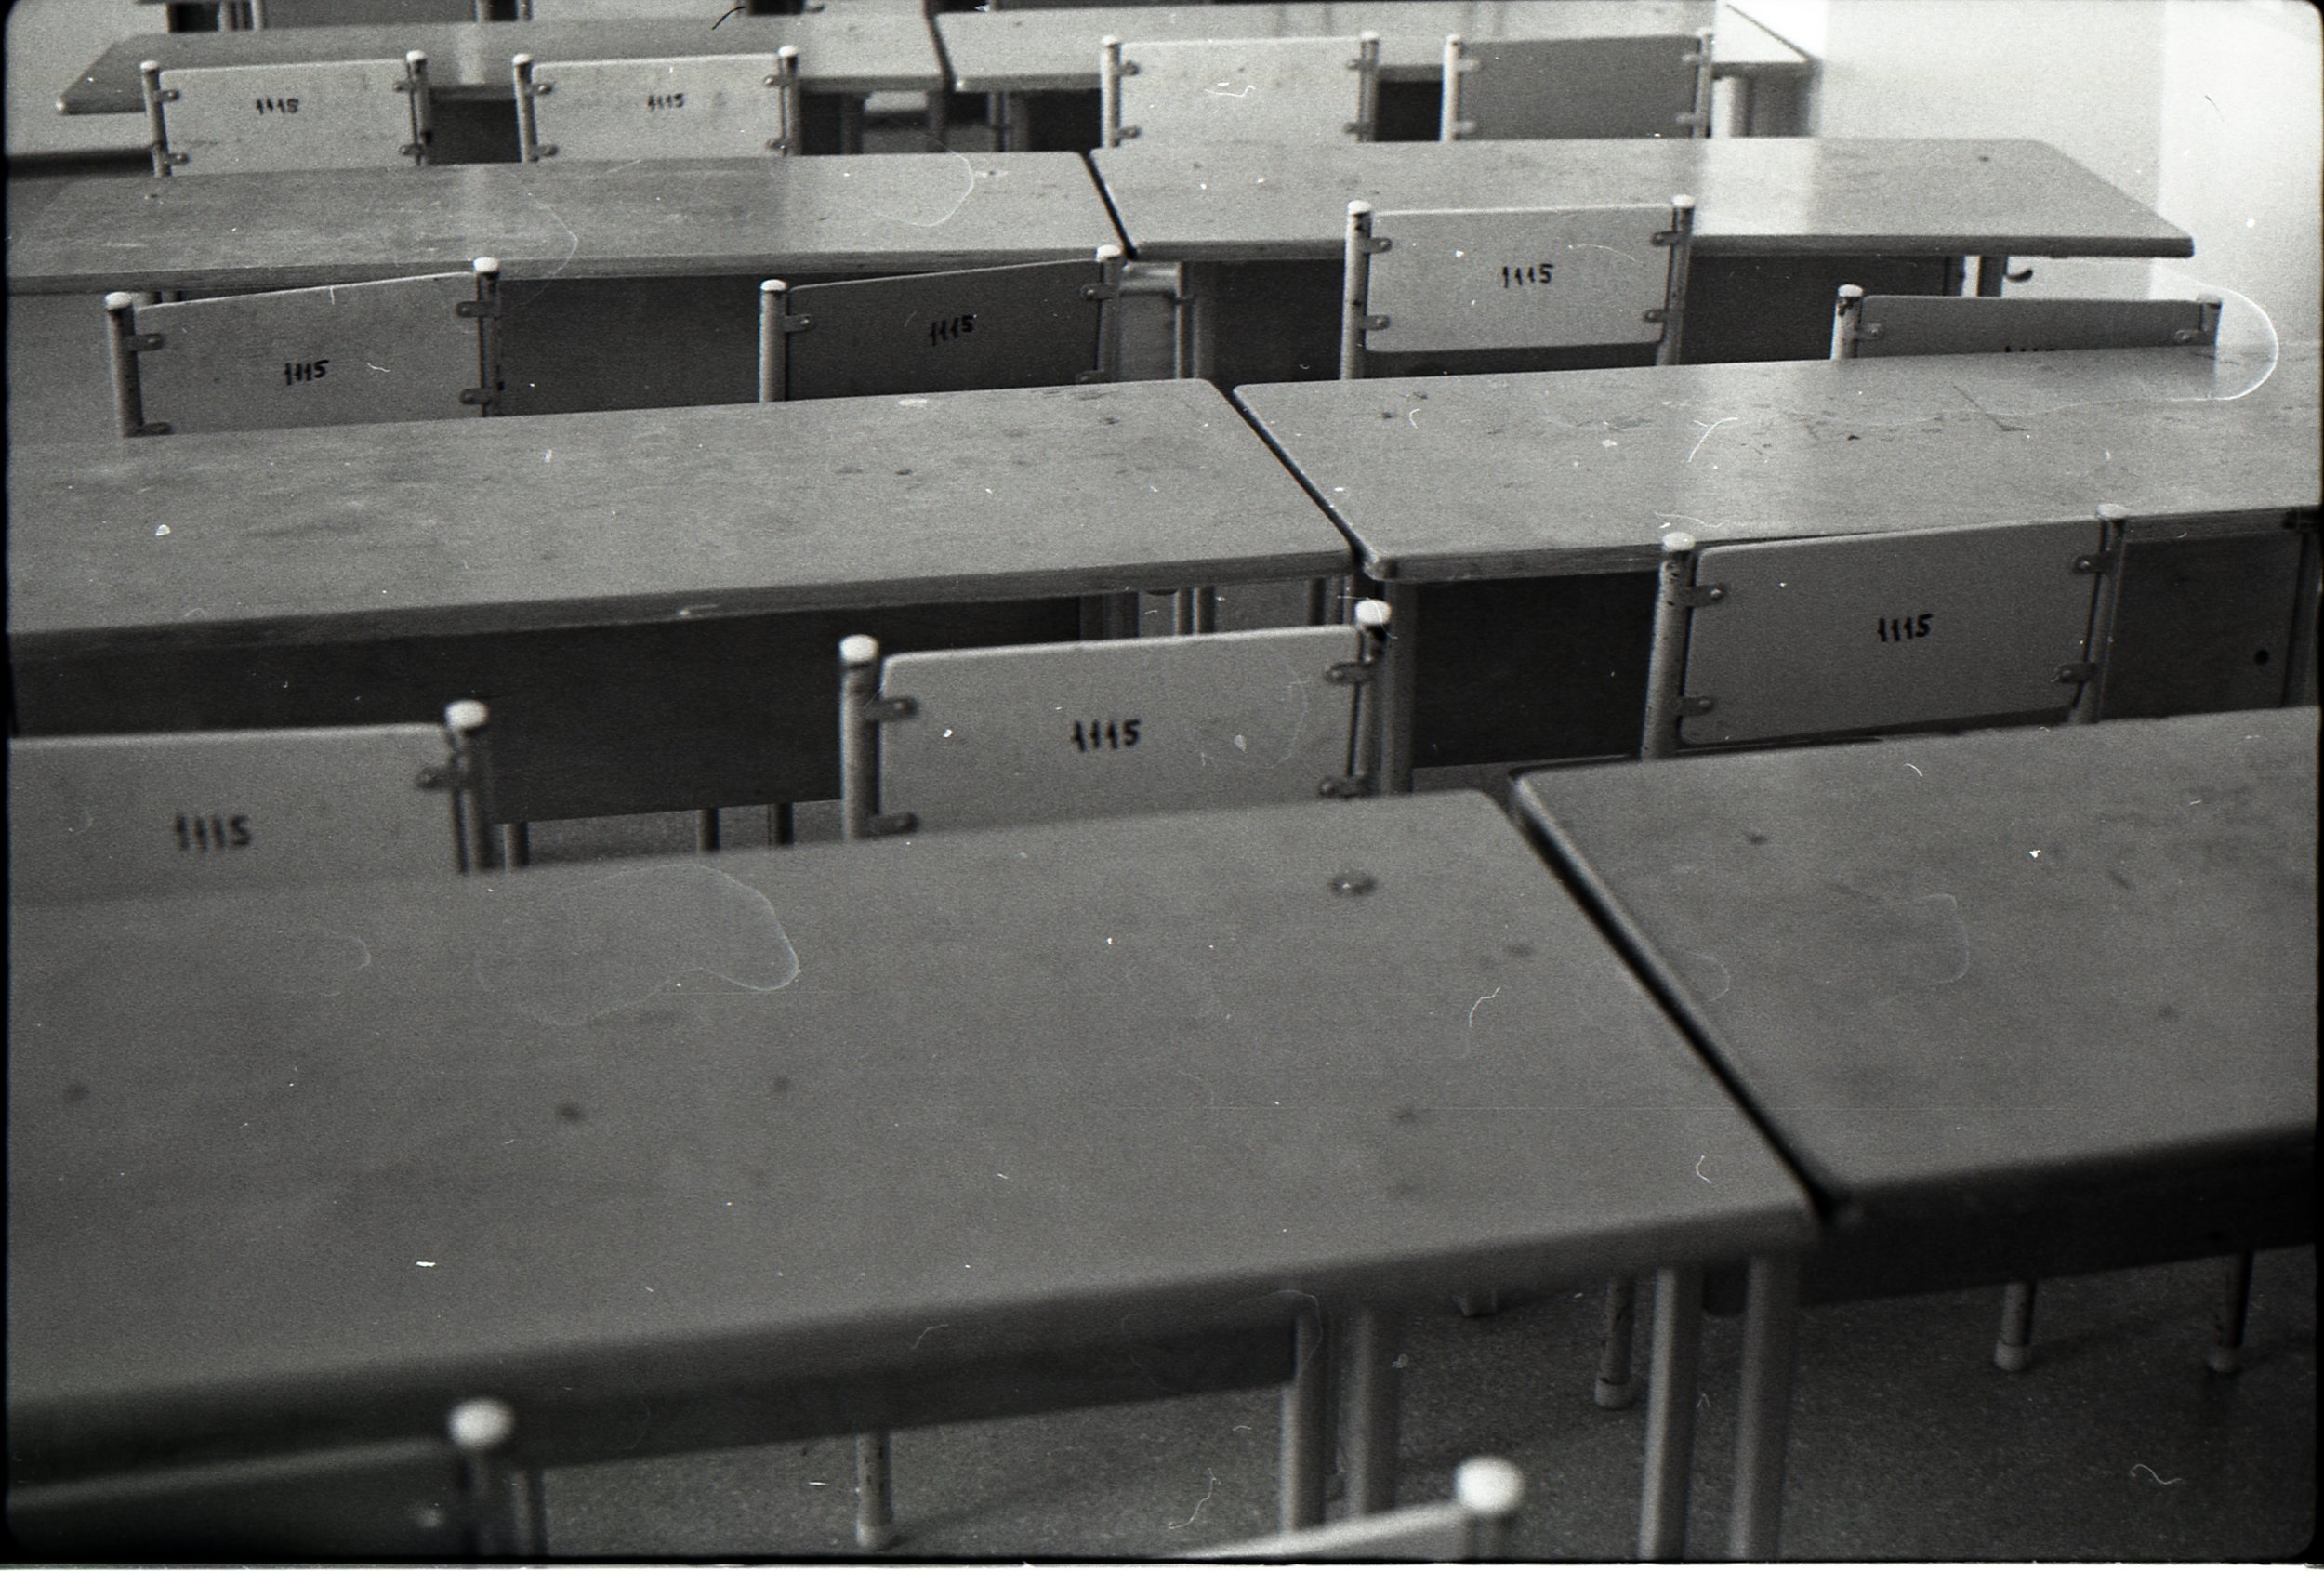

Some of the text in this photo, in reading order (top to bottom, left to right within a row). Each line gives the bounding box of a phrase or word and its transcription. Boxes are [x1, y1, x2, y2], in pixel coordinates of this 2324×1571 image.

[256, 98, 298, 114] 1115
[648, 93, 685, 111] 1115
[1503, 264, 1553, 288] 1115
[930, 315, 974, 347] 1115
[284, 360, 329, 385] 1115
[1878, 614, 1933, 642] 1115
[1072, 719, 1141, 752] 1115
[175, 812, 252, 852] 1115
